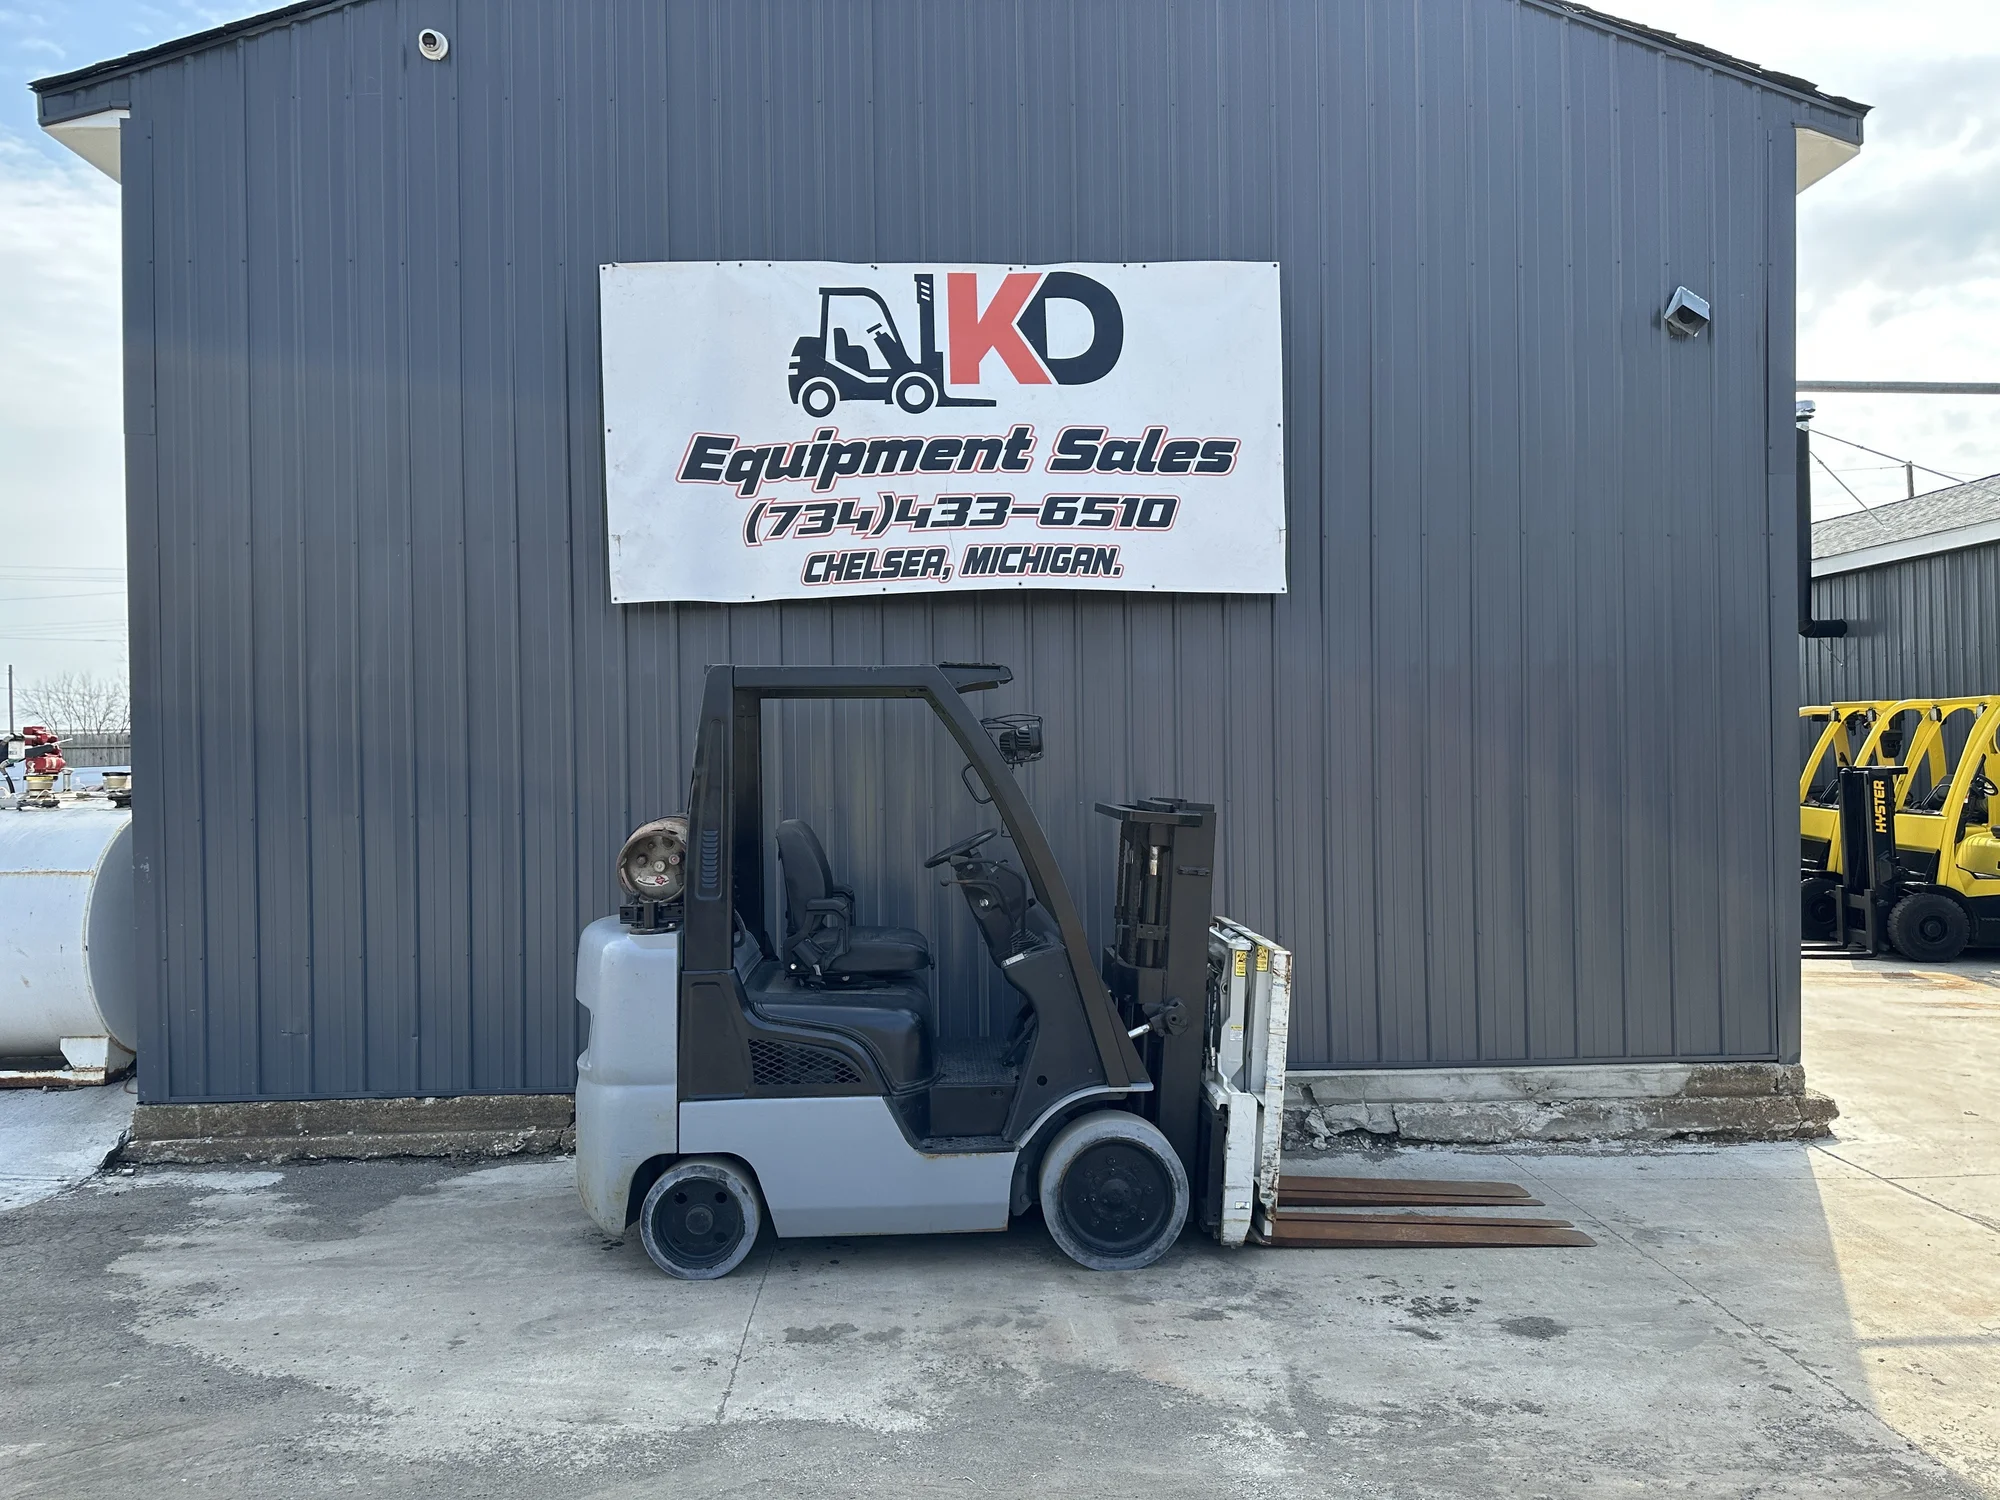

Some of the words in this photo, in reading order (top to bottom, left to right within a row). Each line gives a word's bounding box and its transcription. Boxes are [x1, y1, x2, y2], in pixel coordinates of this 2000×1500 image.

[947, 271, 1124, 386] KD
[677, 425, 1035, 498] Equipment
[1047, 425, 1241, 476] Sales
[743, 492, 1180, 547] (734)433-6510
[801, 547, 954, 586] CHELSEA,
[960, 543, 1124, 577] MICHIGAN.
[1873, 779, 1887, 833] HYSTER
